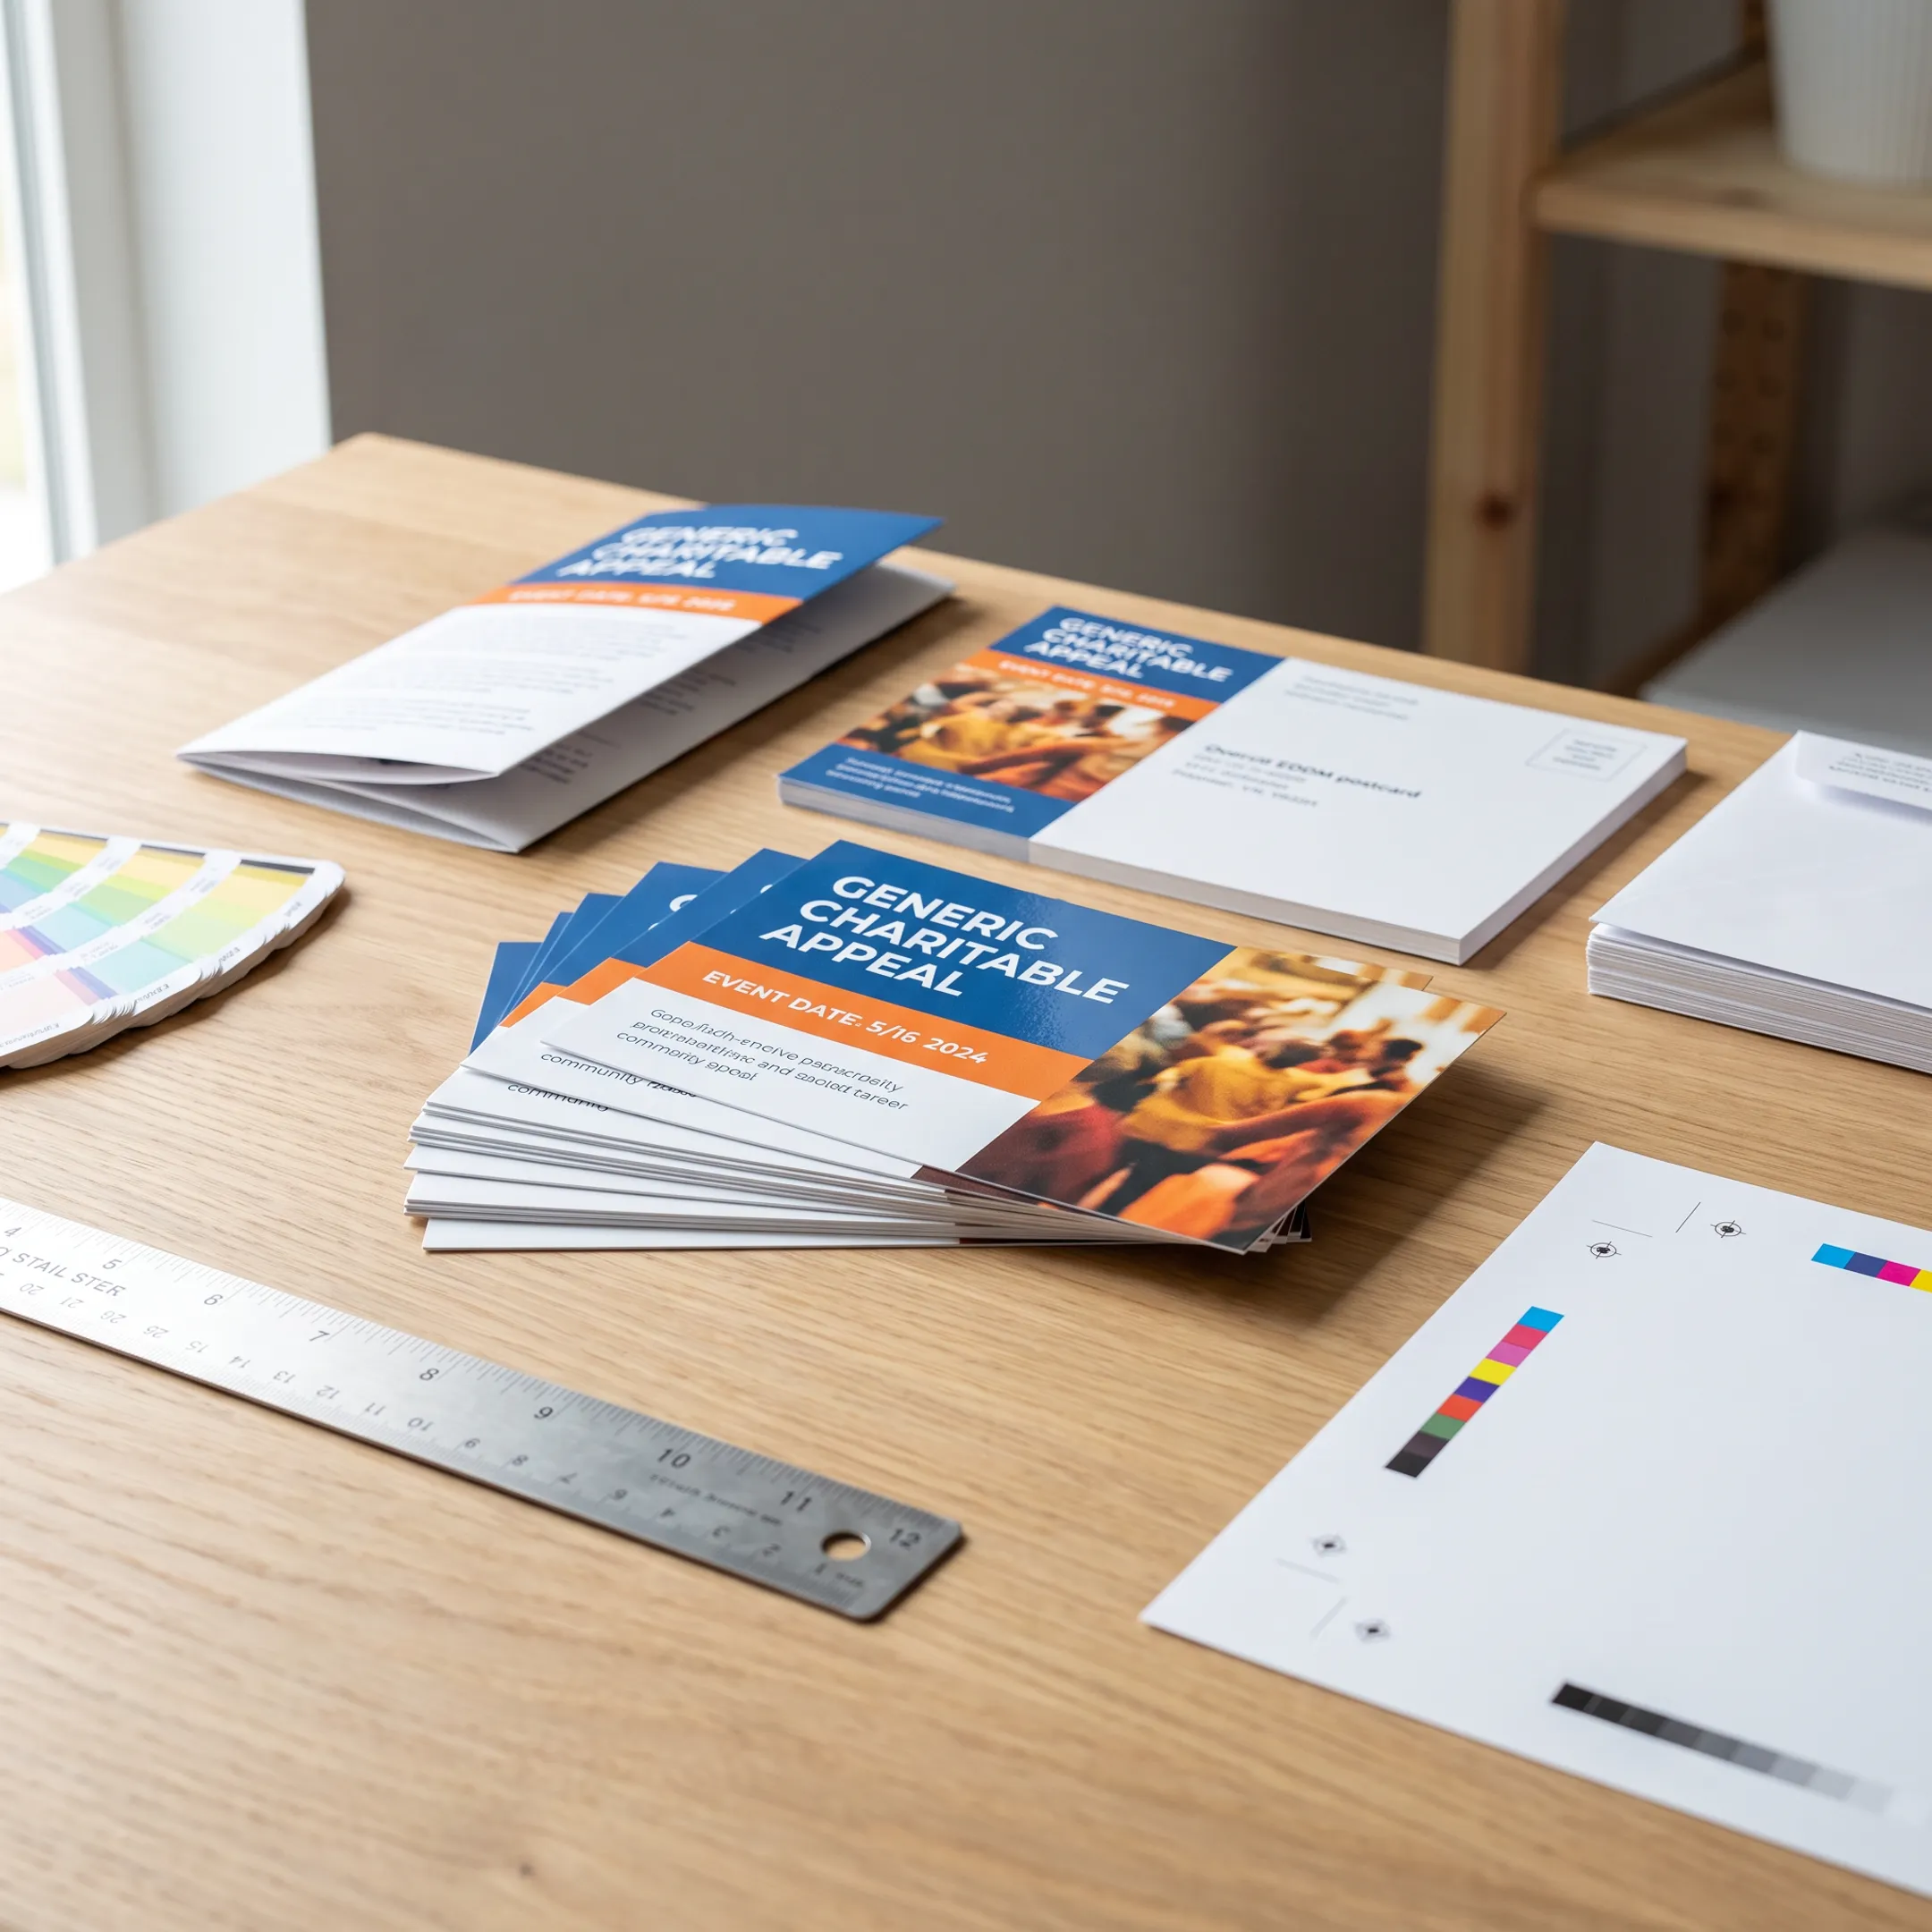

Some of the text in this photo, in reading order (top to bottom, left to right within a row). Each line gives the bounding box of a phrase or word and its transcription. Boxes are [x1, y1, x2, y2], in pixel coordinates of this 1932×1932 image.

[622, 526, 799, 547] GENERIC
[591, 540, 843, 570] CHARITABLE
[555, 557, 716, 579] APPEAL
[1060, 617, 1194, 658] GENERIC
[1023, 640, 1144, 679] APPEAL
[1042, 628, 1234, 682] CHARITABLE
[833, 876, 1058, 950] GENERIC
[758, 924, 964, 996] APPEAL
[800, 900, 1130, 1004] CHARITABLE
[702, 970, 790, 1003] EVENT
[865, 1021, 920, 1044] 5/16
[923, 1038, 988, 1063] 2024
[758, 1061, 796, 1076] and
[13, 1252, 68, 1279] STAIL
[20, 1283, 45, 1295] 20
[60, 1297, 84, 1309] 21
[185, 1340, 210, 1354] 15
[228, 1355, 251, 1369] 14
[273, 1369, 296, 1385] 13
[4, 1226, 22, 1237] 4
[103, 1258, 123, 1270] 5
[309, 1330, 330, 1343] 7
[419, 1368, 440, 1381] 8
[533, 1406, 554, 1420] 9
[658, 1448, 691, 1469] 10
[780, 1491, 812, 1512] 11
[890, 1528, 922, 1551] 12
[316, 1385, 340, 1401] 12
[363, 1402, 386, 1416] 11
[407, 1417, 434, 1432] 10
